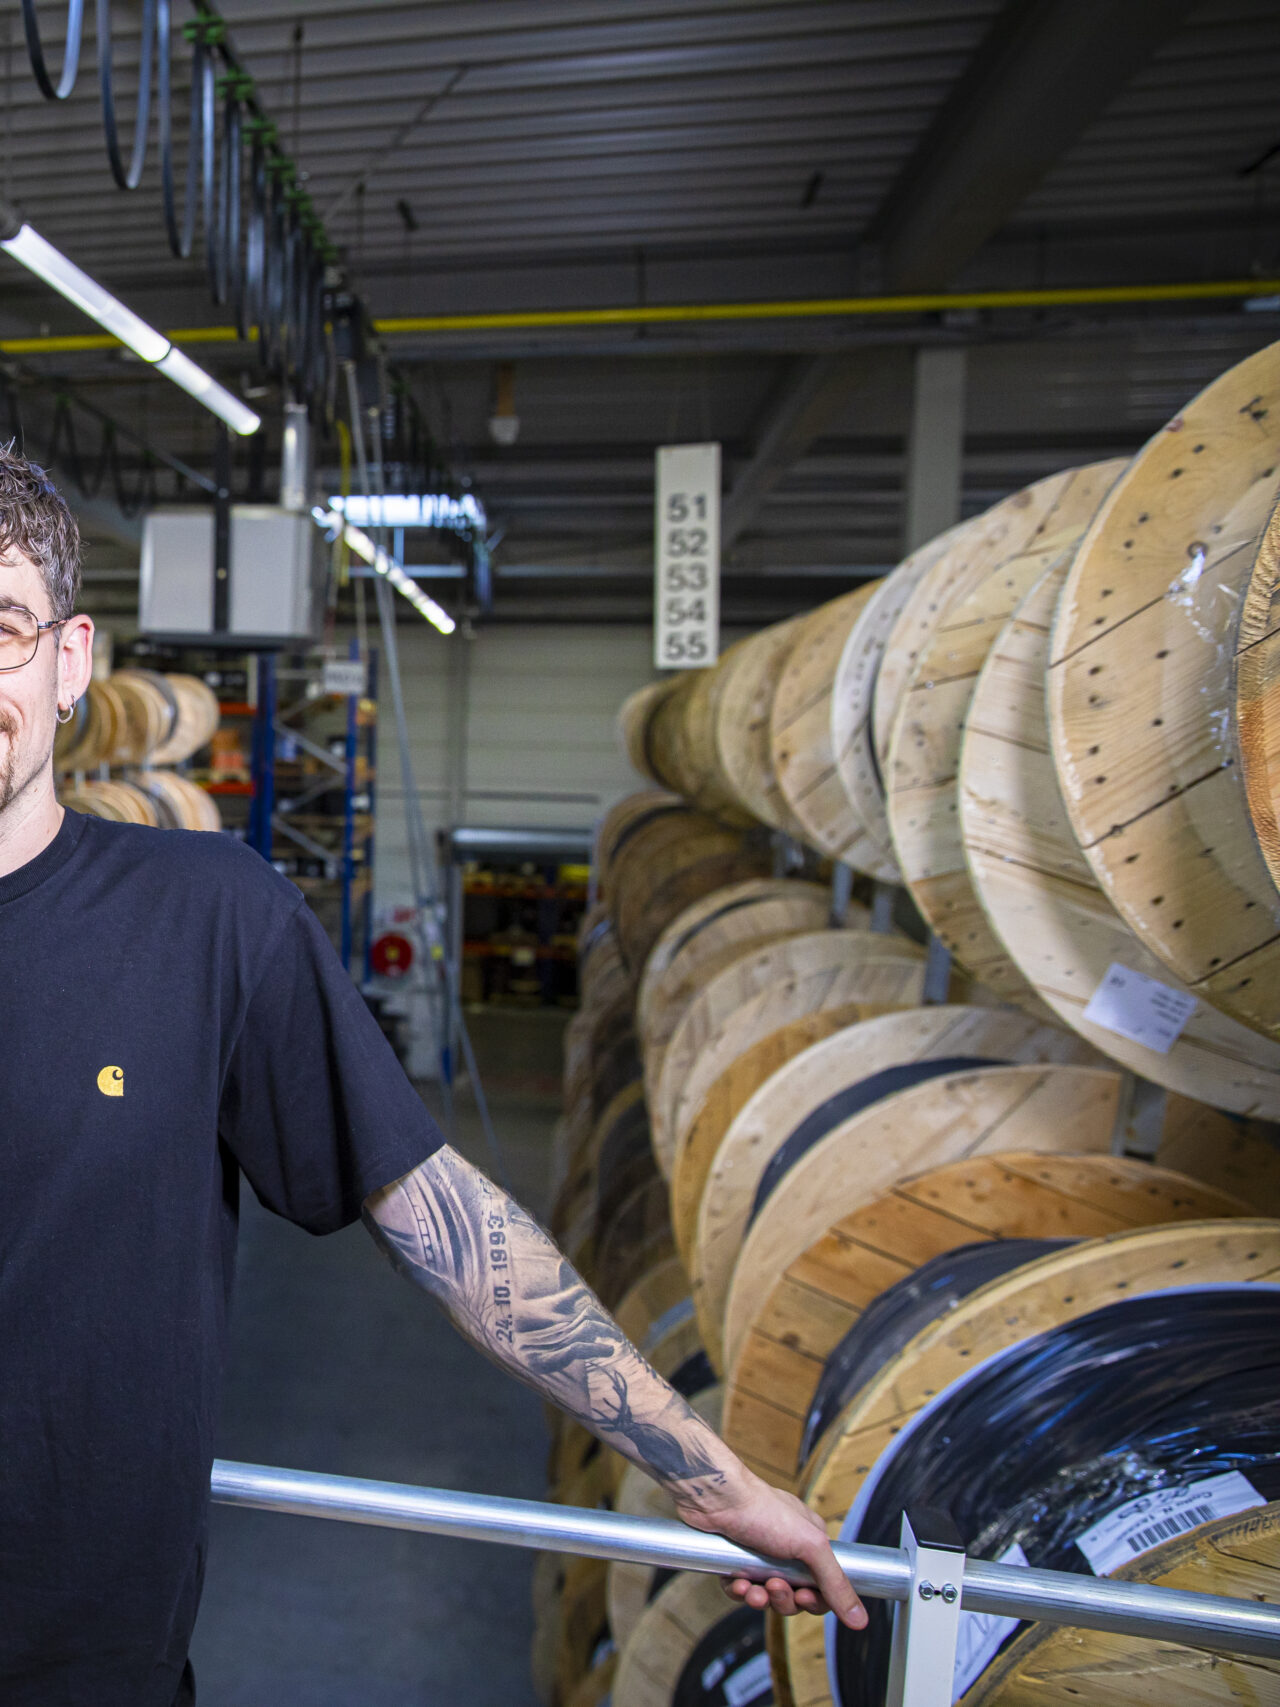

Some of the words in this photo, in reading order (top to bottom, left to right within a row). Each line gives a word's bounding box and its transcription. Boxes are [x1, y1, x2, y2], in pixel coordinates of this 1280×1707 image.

[667, 493, 707, 523] 51
[666, 527, 708, 558] 52
[665, 562, 708, 593] 53
[665, 598, 706, 627] 54
[664, 632, 708, 661] 55
[487, 1213, 508, 1271] 1993
[493, 1279, 512, 1306] 10.
